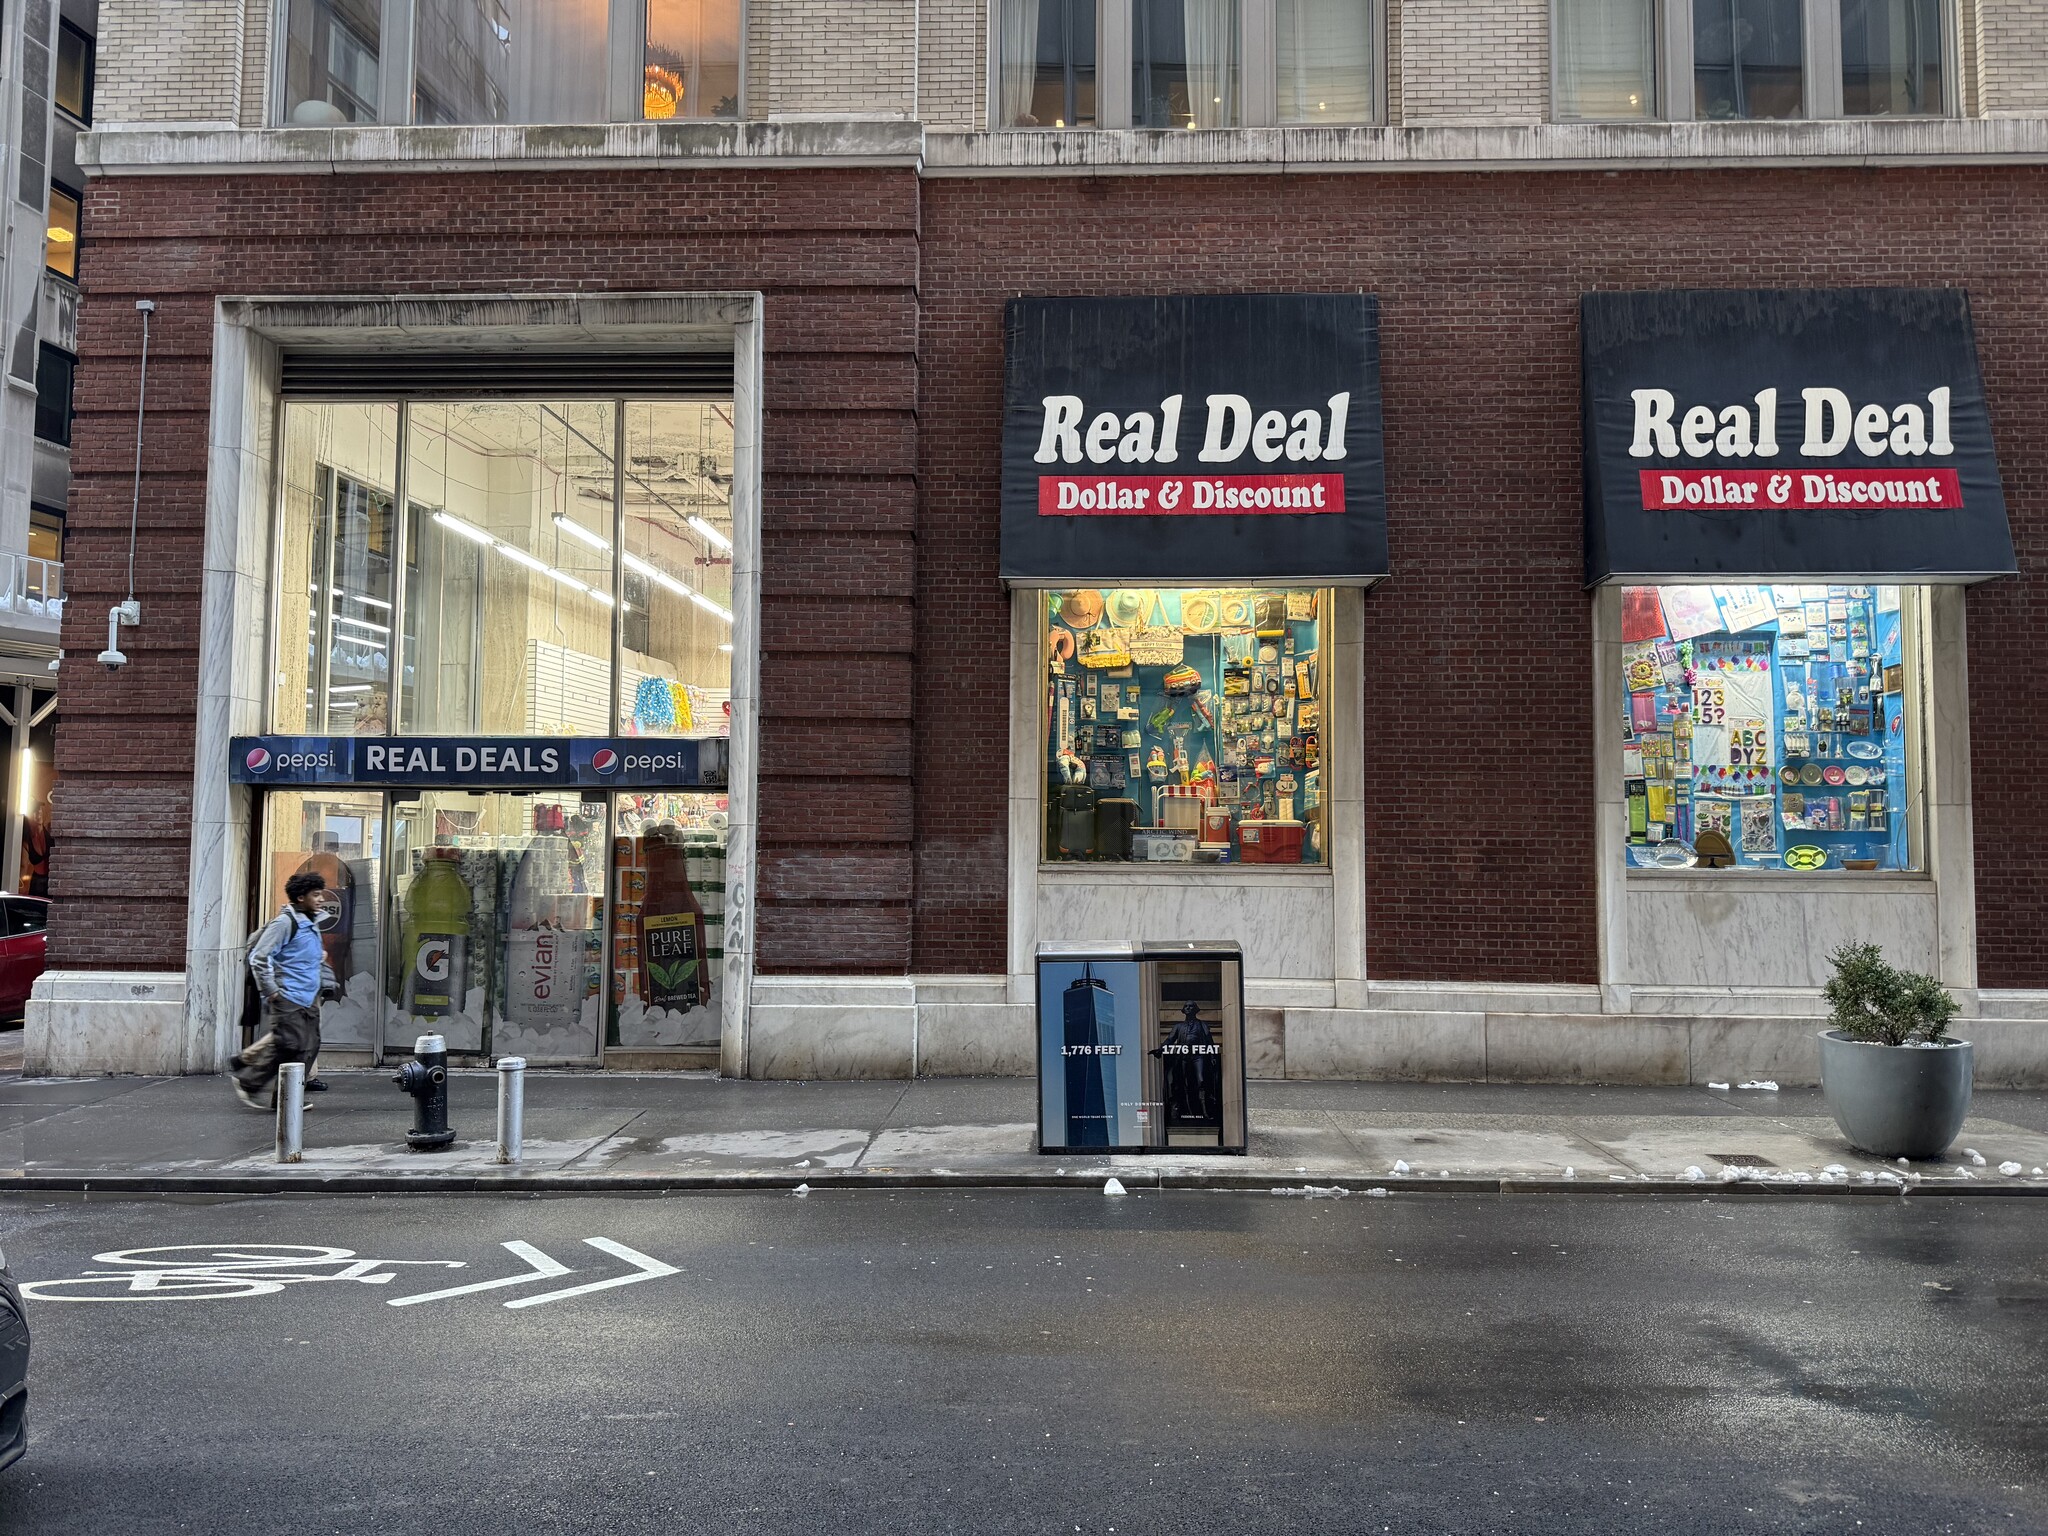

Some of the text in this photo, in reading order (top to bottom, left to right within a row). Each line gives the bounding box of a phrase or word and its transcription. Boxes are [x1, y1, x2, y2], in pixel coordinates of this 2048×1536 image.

[1033, 391, 1350, 464] Real Deal
[1628, 386, 1955, 458] Real Deal
[1057, 480, 1326, 510] Dollar & Discount
[1660, 474, 1943, 504] Dollar & Discount
[276, 749, 335, 772] pepsi
[366, 745, 559, 773] REAL DEALS
[623, 751, 683, 773] pepsi
[651, 929, 692, 945] PURE
[652, 941, 693, 957] LEAF
[416, 940, 450, 981] G
[531, 934, 554, 1000] evian
[1060, 1045, 1123, 1057] 1,776 FEET
[1162, 1044, 1220, 1055] 1776 FEAT
